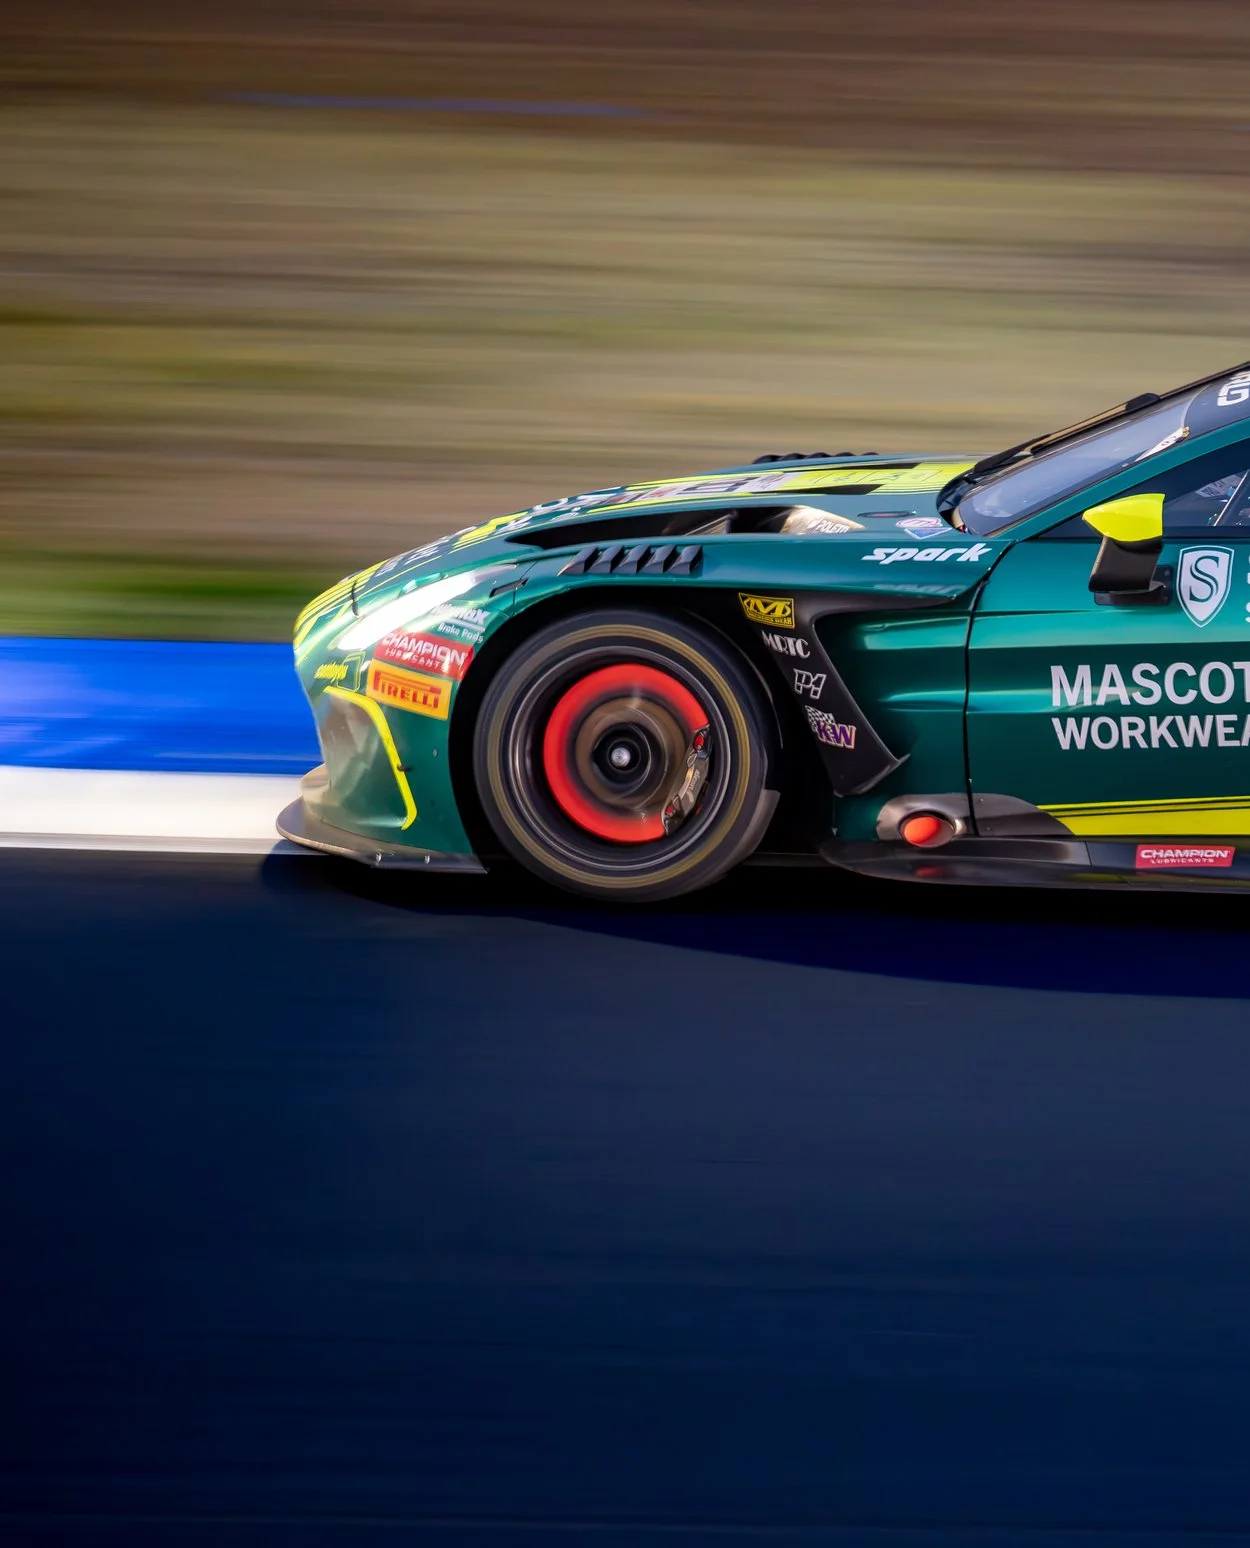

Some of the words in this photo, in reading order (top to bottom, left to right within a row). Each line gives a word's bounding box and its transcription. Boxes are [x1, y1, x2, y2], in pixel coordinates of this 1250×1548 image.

[861, 543, 992, 565] spark
[382, 634, 468, 666] CHAMPION
[373, 669, 441, 708] PIRELLI
[1141, 849, 1230, 858] CHAMPION
